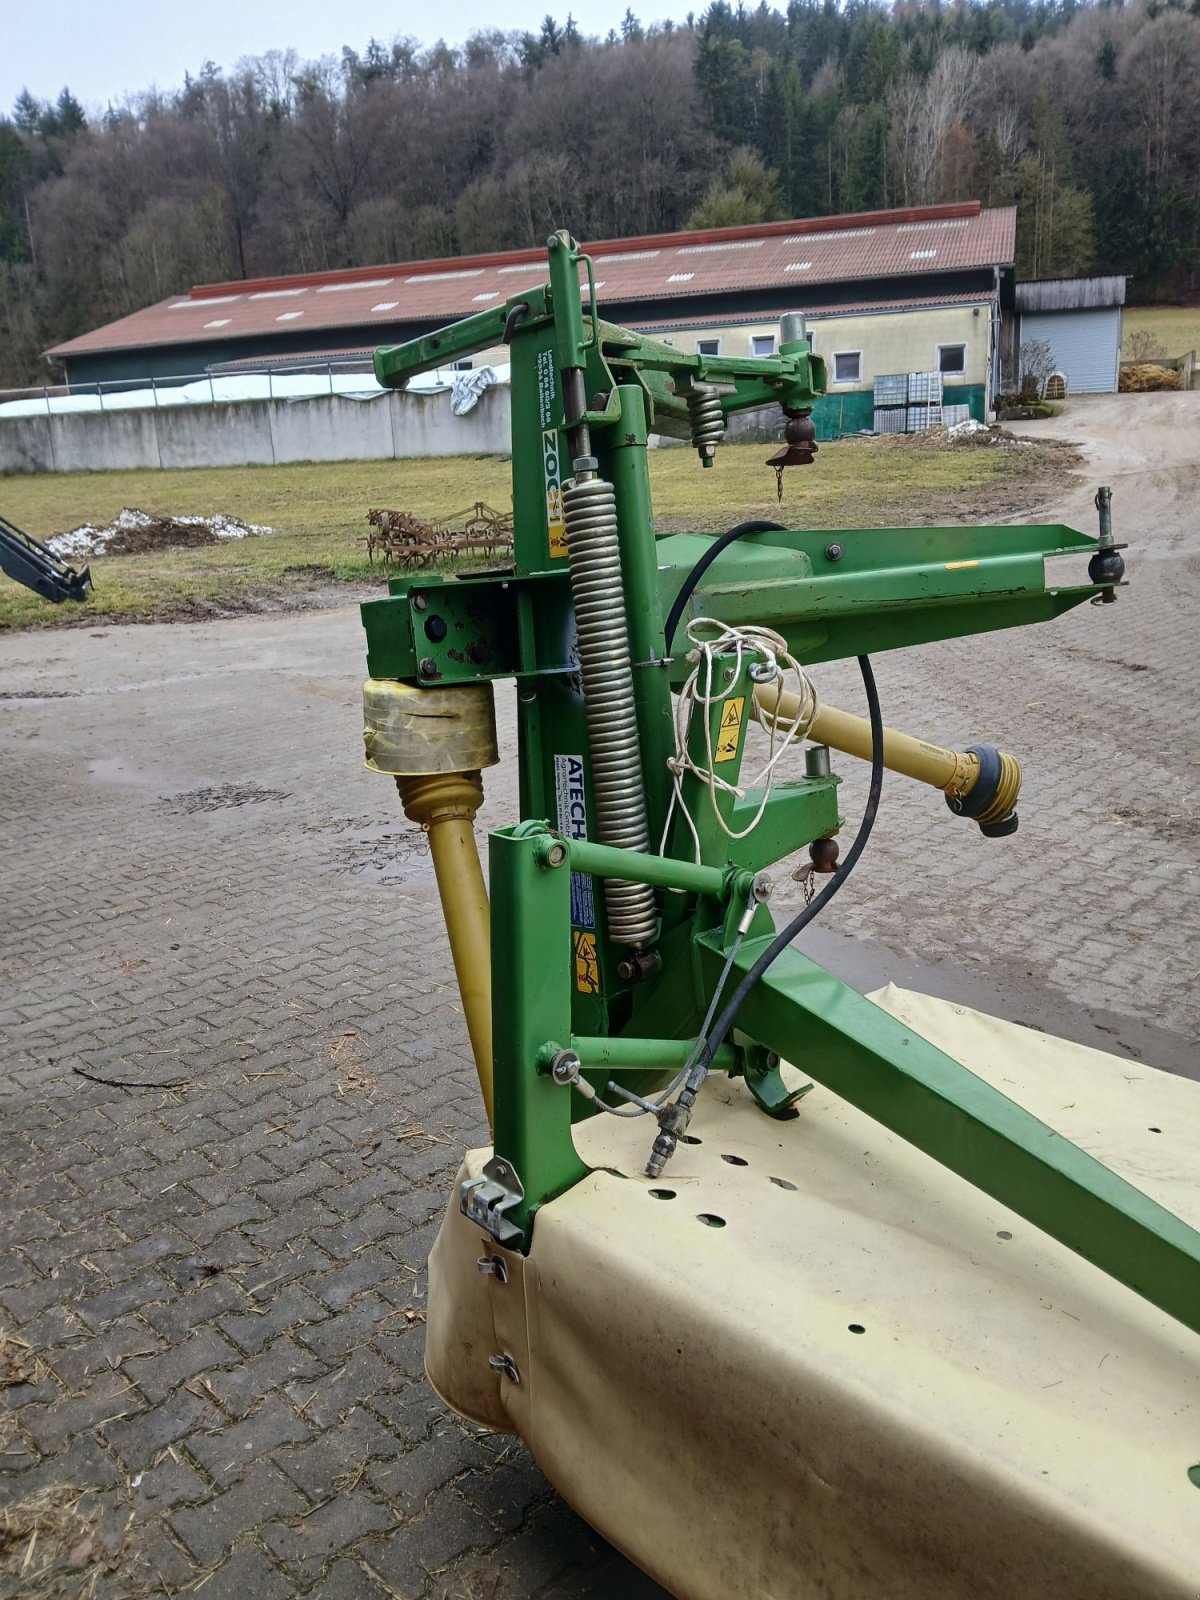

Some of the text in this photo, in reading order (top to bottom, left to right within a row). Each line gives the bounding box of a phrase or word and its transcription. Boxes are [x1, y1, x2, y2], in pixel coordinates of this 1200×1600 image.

[548, 349, 556, 400] Landtechnik
[561, 757, 569, 810] Agrartechnik
[568, 757, 586, 839] ATECH
